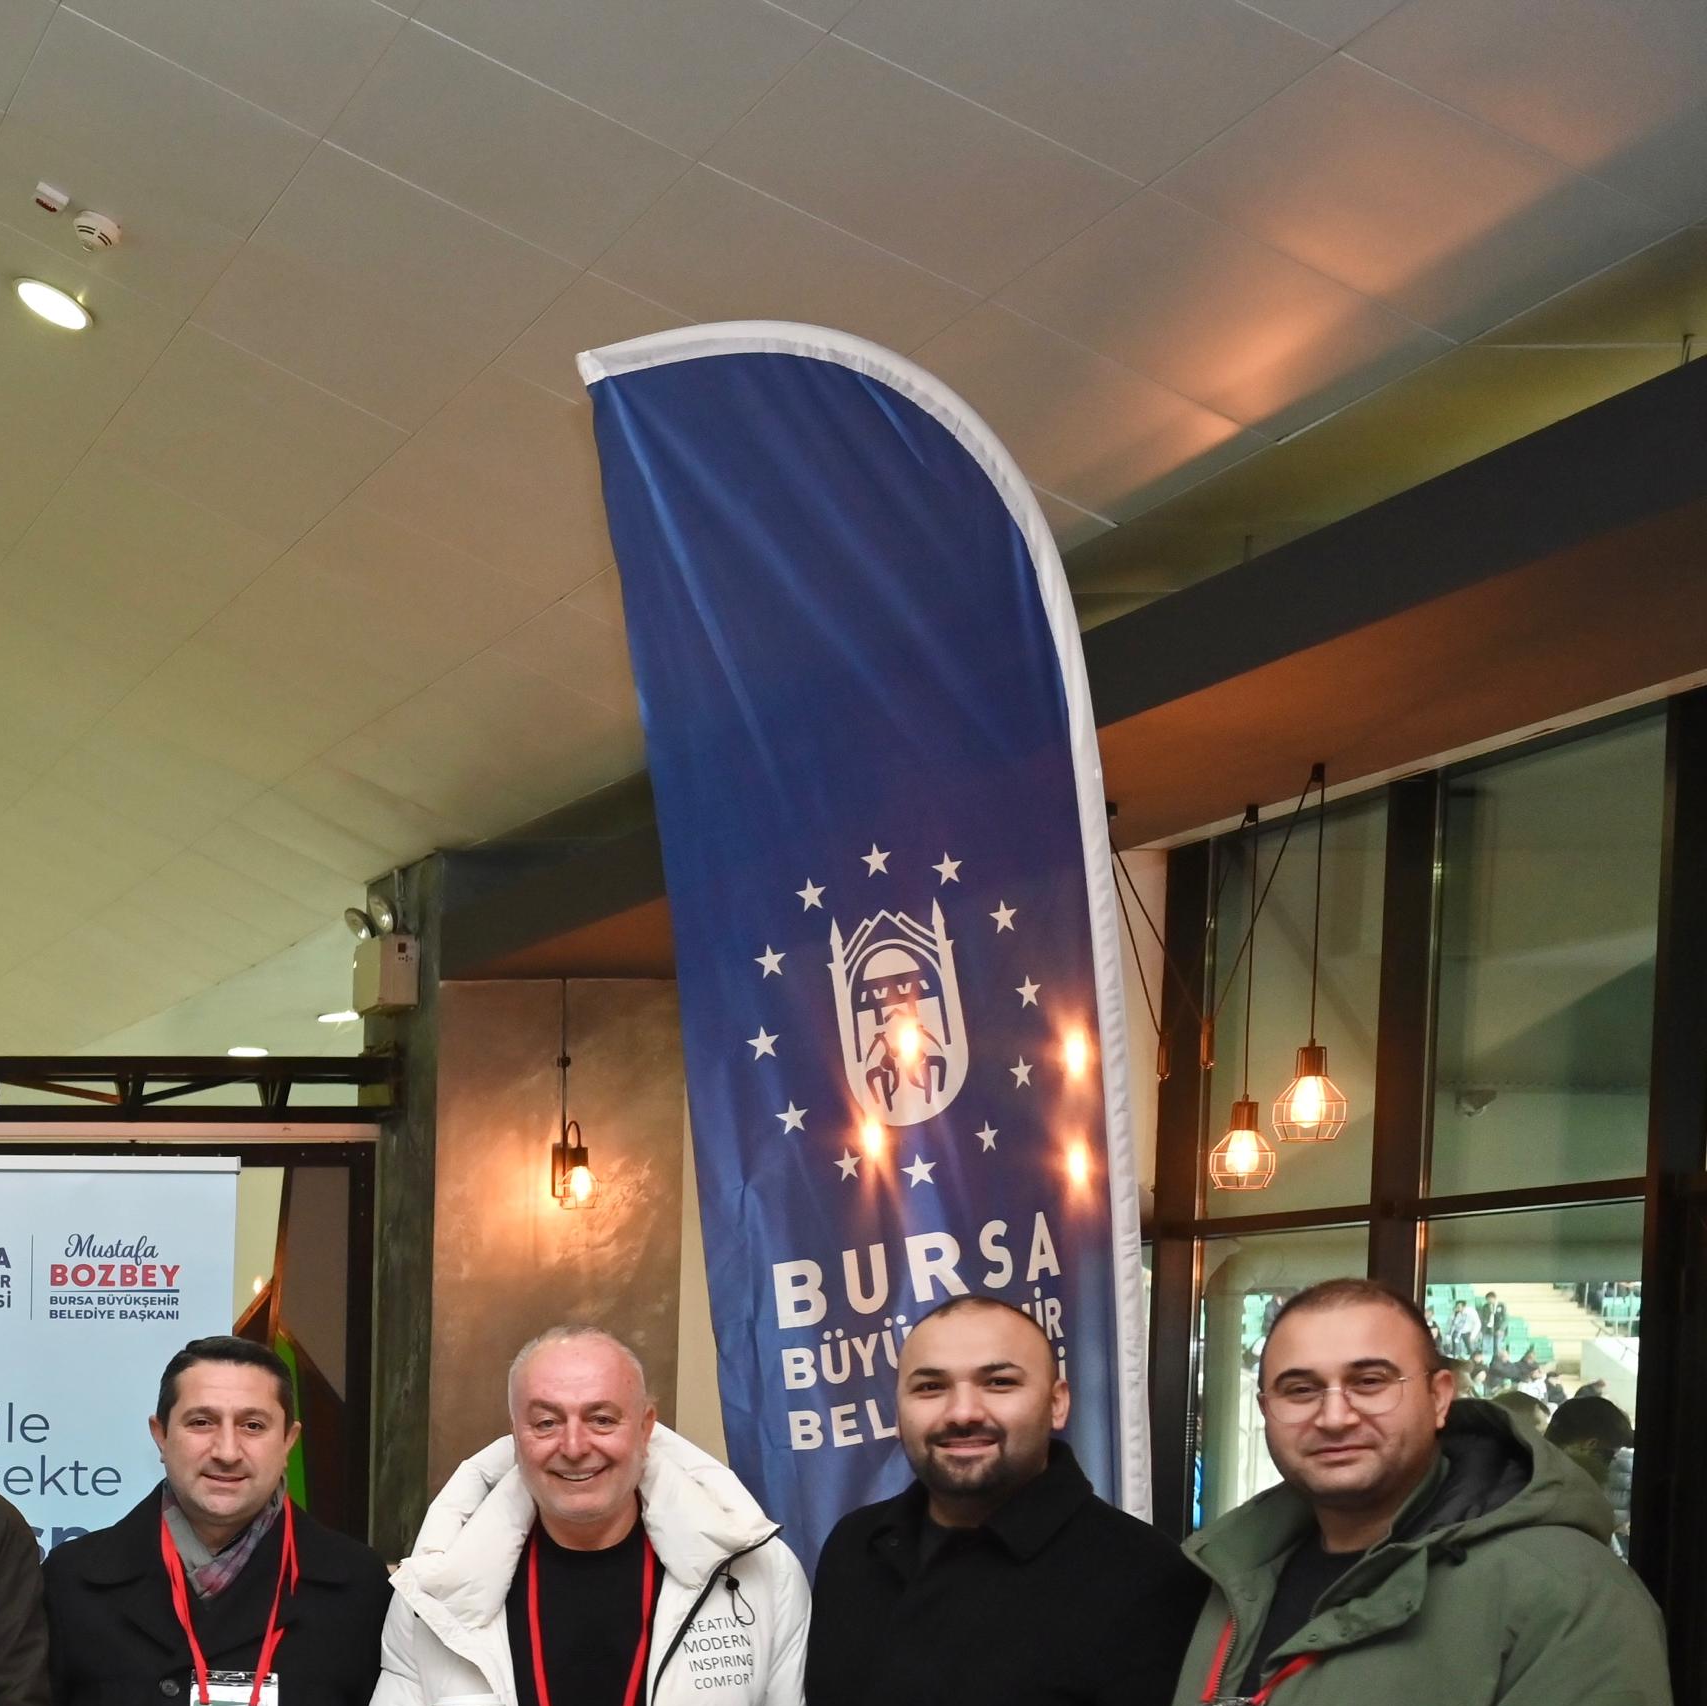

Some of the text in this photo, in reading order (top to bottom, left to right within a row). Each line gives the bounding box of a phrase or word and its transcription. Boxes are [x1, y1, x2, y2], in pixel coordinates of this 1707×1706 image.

[64, 1233, 159, 1266] Mustafa
[49, 1263, 180, 1288] BOZBEY
[772, 1211, 1061, 1329] BURSA
[49, 1293, 180, 1308] BURSA BÜYÜKŞEHİR
[49, 1307, 180, 1323] BELEDİYE BAŞKANI
[682, 1634, 752, 1654] MODERN
[689, 1653, 754, 1673] INSPIRING
